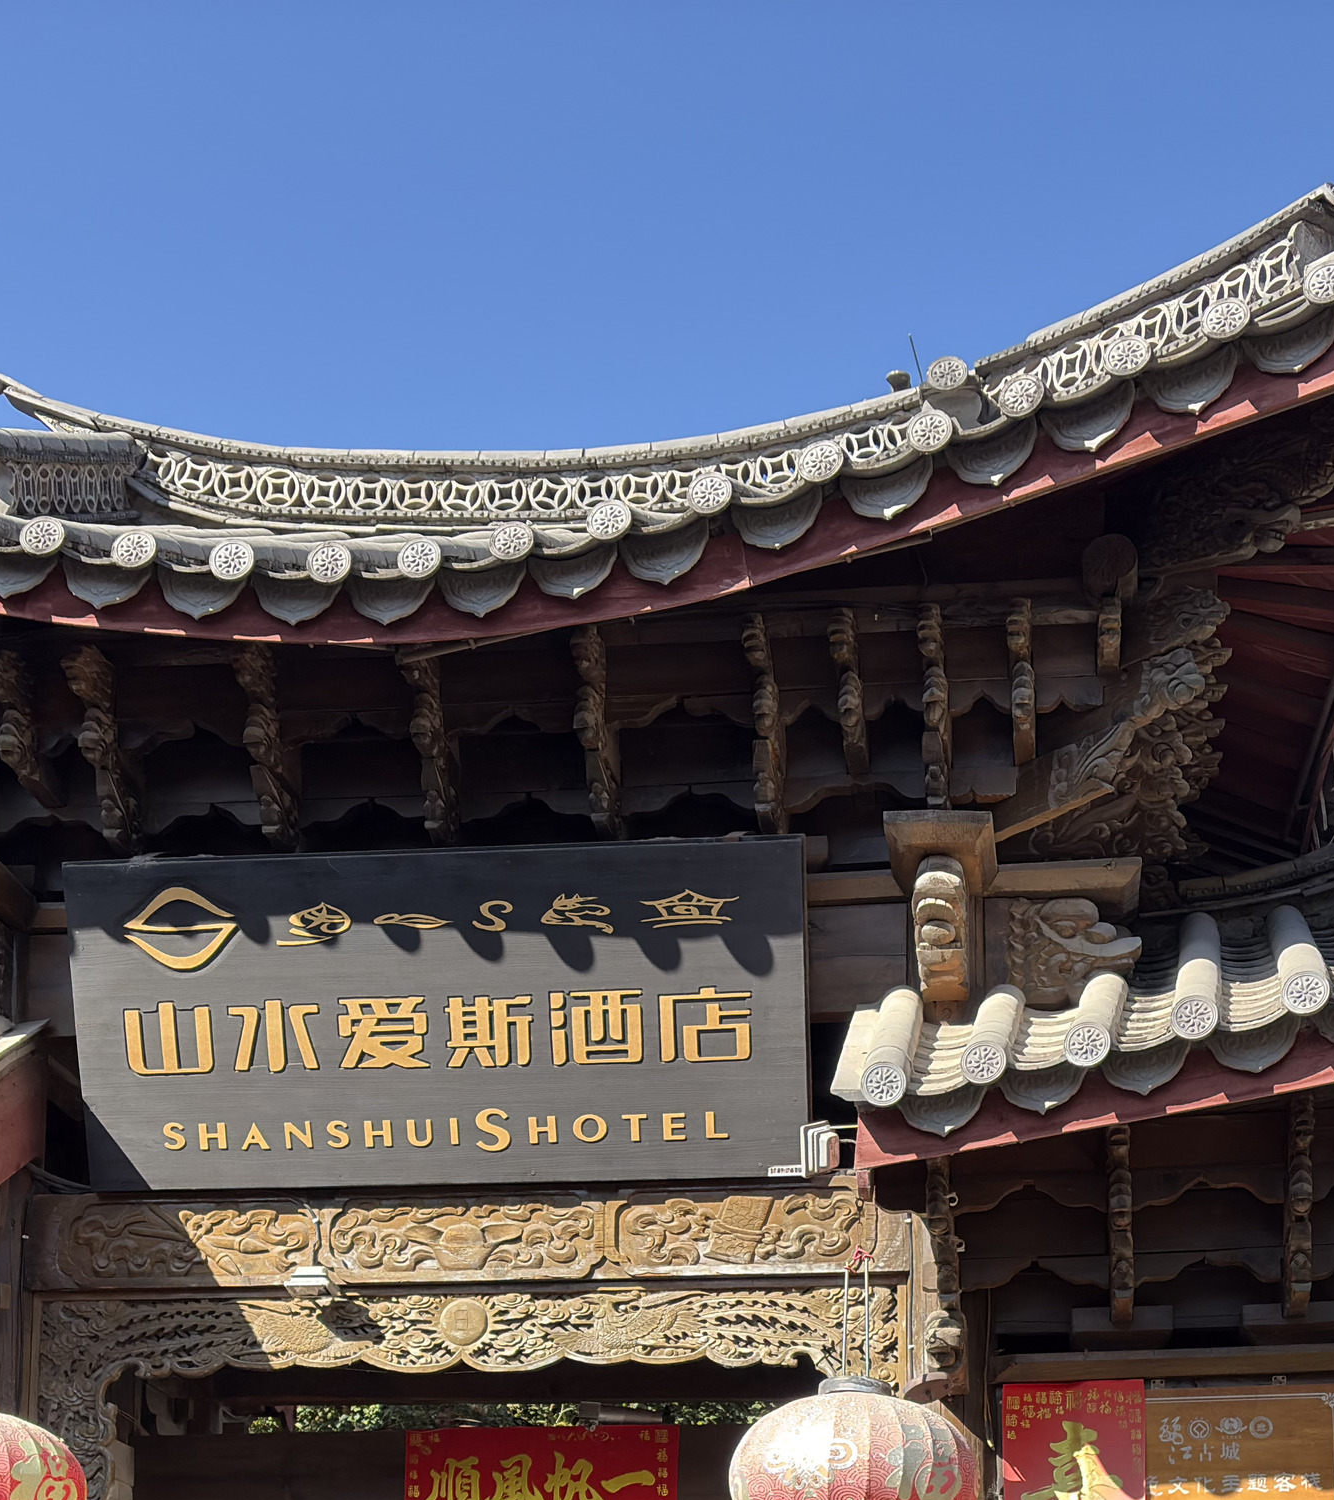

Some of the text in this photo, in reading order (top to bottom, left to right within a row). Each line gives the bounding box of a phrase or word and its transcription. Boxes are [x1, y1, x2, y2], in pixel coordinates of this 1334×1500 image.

[122, 986, 754, 1076] 山水爱斯酒店
[163, 1116, 461, 1152] SHANSHUI
[527, 1110, 730, 1145] HOTEL
